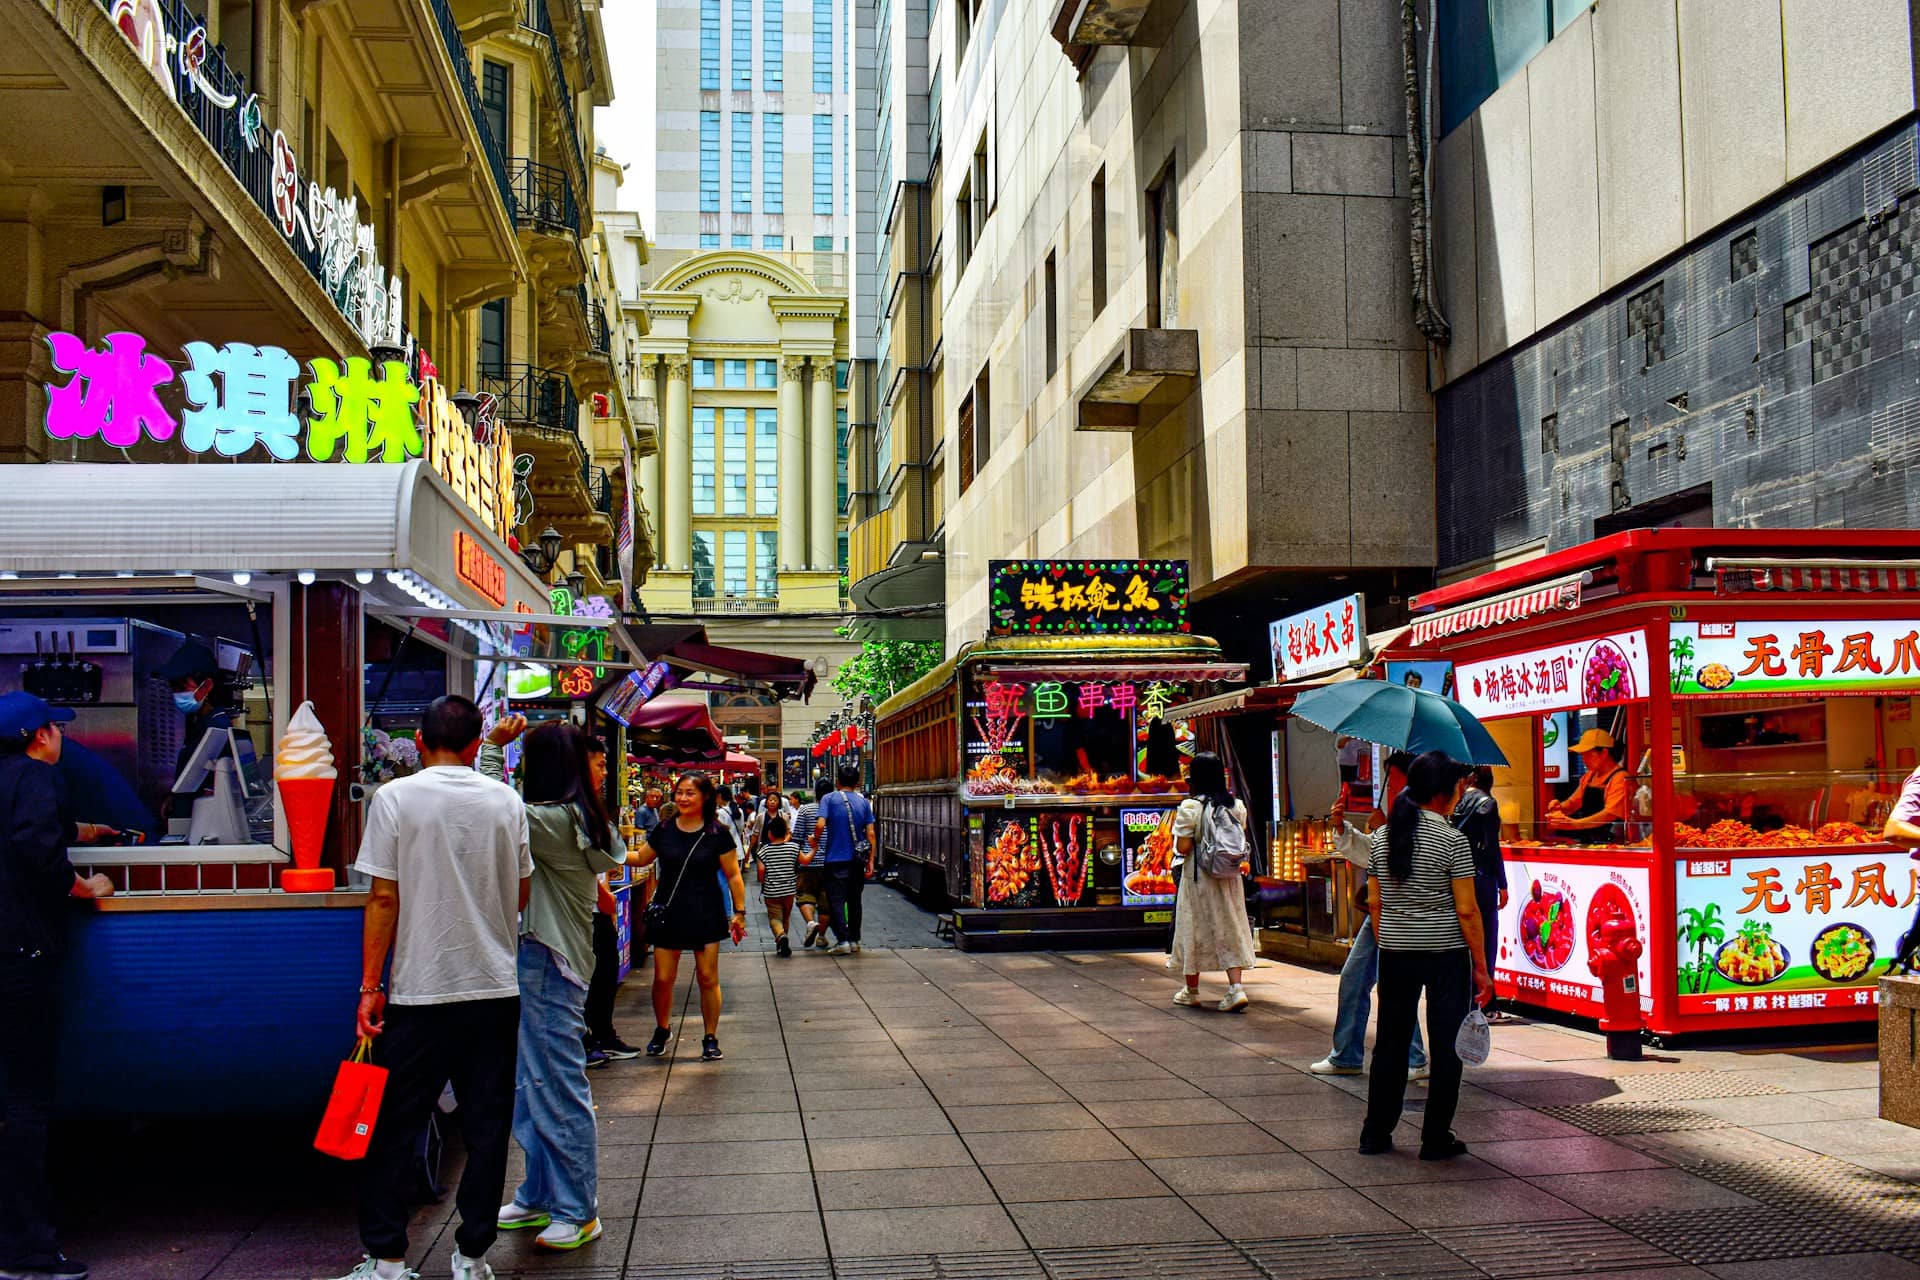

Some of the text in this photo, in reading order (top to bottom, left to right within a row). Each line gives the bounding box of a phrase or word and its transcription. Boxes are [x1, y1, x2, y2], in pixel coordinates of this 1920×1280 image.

[44, 331, 424, 464] 冰淇淋
[1288, 599, 1355, 665] 超级大串
[1738, 630, 1920, 678] 无骨凤爪
[1484, 655, 1569, 704] 杨梅冰汤圆
[1736, 862, 1915, 914] 无骨凤
